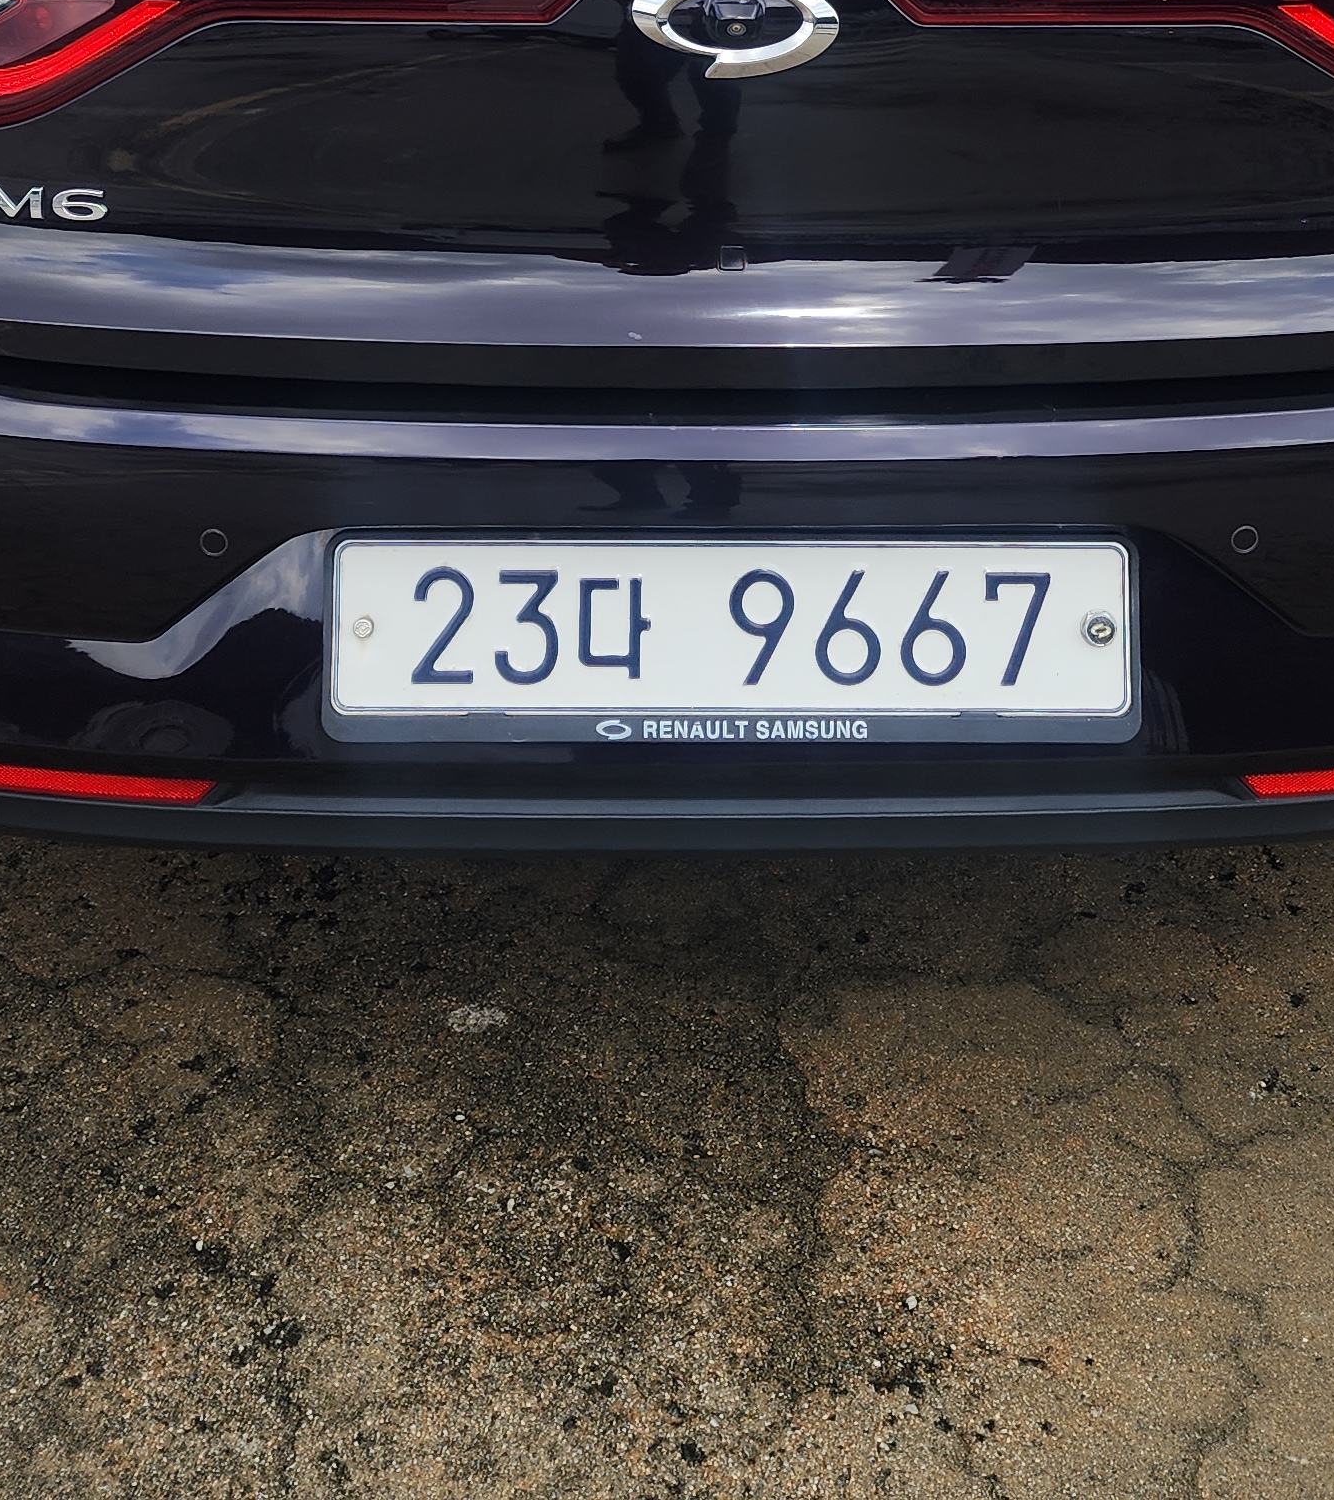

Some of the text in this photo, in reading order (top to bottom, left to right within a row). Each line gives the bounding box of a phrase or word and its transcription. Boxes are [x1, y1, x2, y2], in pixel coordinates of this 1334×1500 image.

[410, 566, 1052, 687] 23다 9667
[643, 720, 868, 739] RENAULT SAMSUNG
